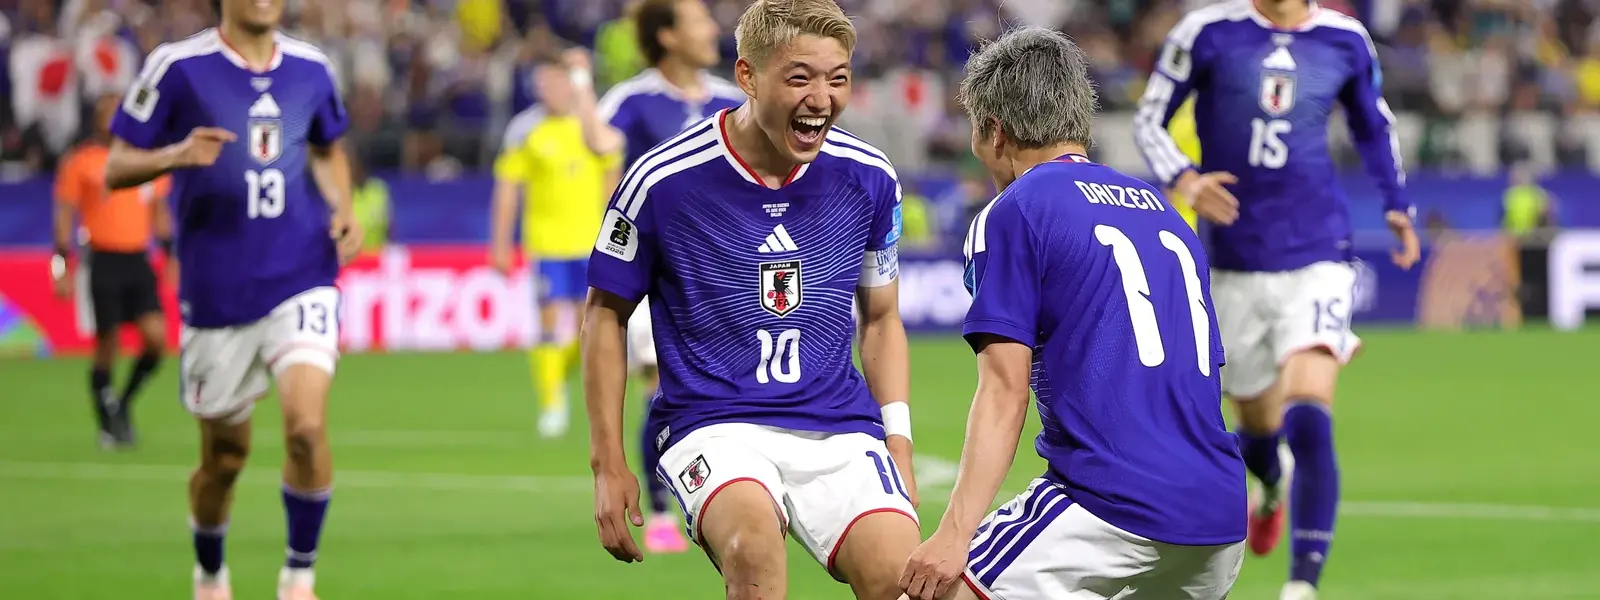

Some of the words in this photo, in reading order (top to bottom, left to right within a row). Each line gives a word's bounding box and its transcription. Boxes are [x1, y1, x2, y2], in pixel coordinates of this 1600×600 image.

[1248, 117, 1292, 169] 15
[244, 168, 286, 219] 13
[1073, 180, 1165, 212] DAIZEN
[769, 262, 791, 270] JAPAN
[296, 301, 328, 336] 13
[1094, 224, 1211, 377] 11
[1313, 297, 1345, 334] 15
[756, 328, 801, 384] 10
